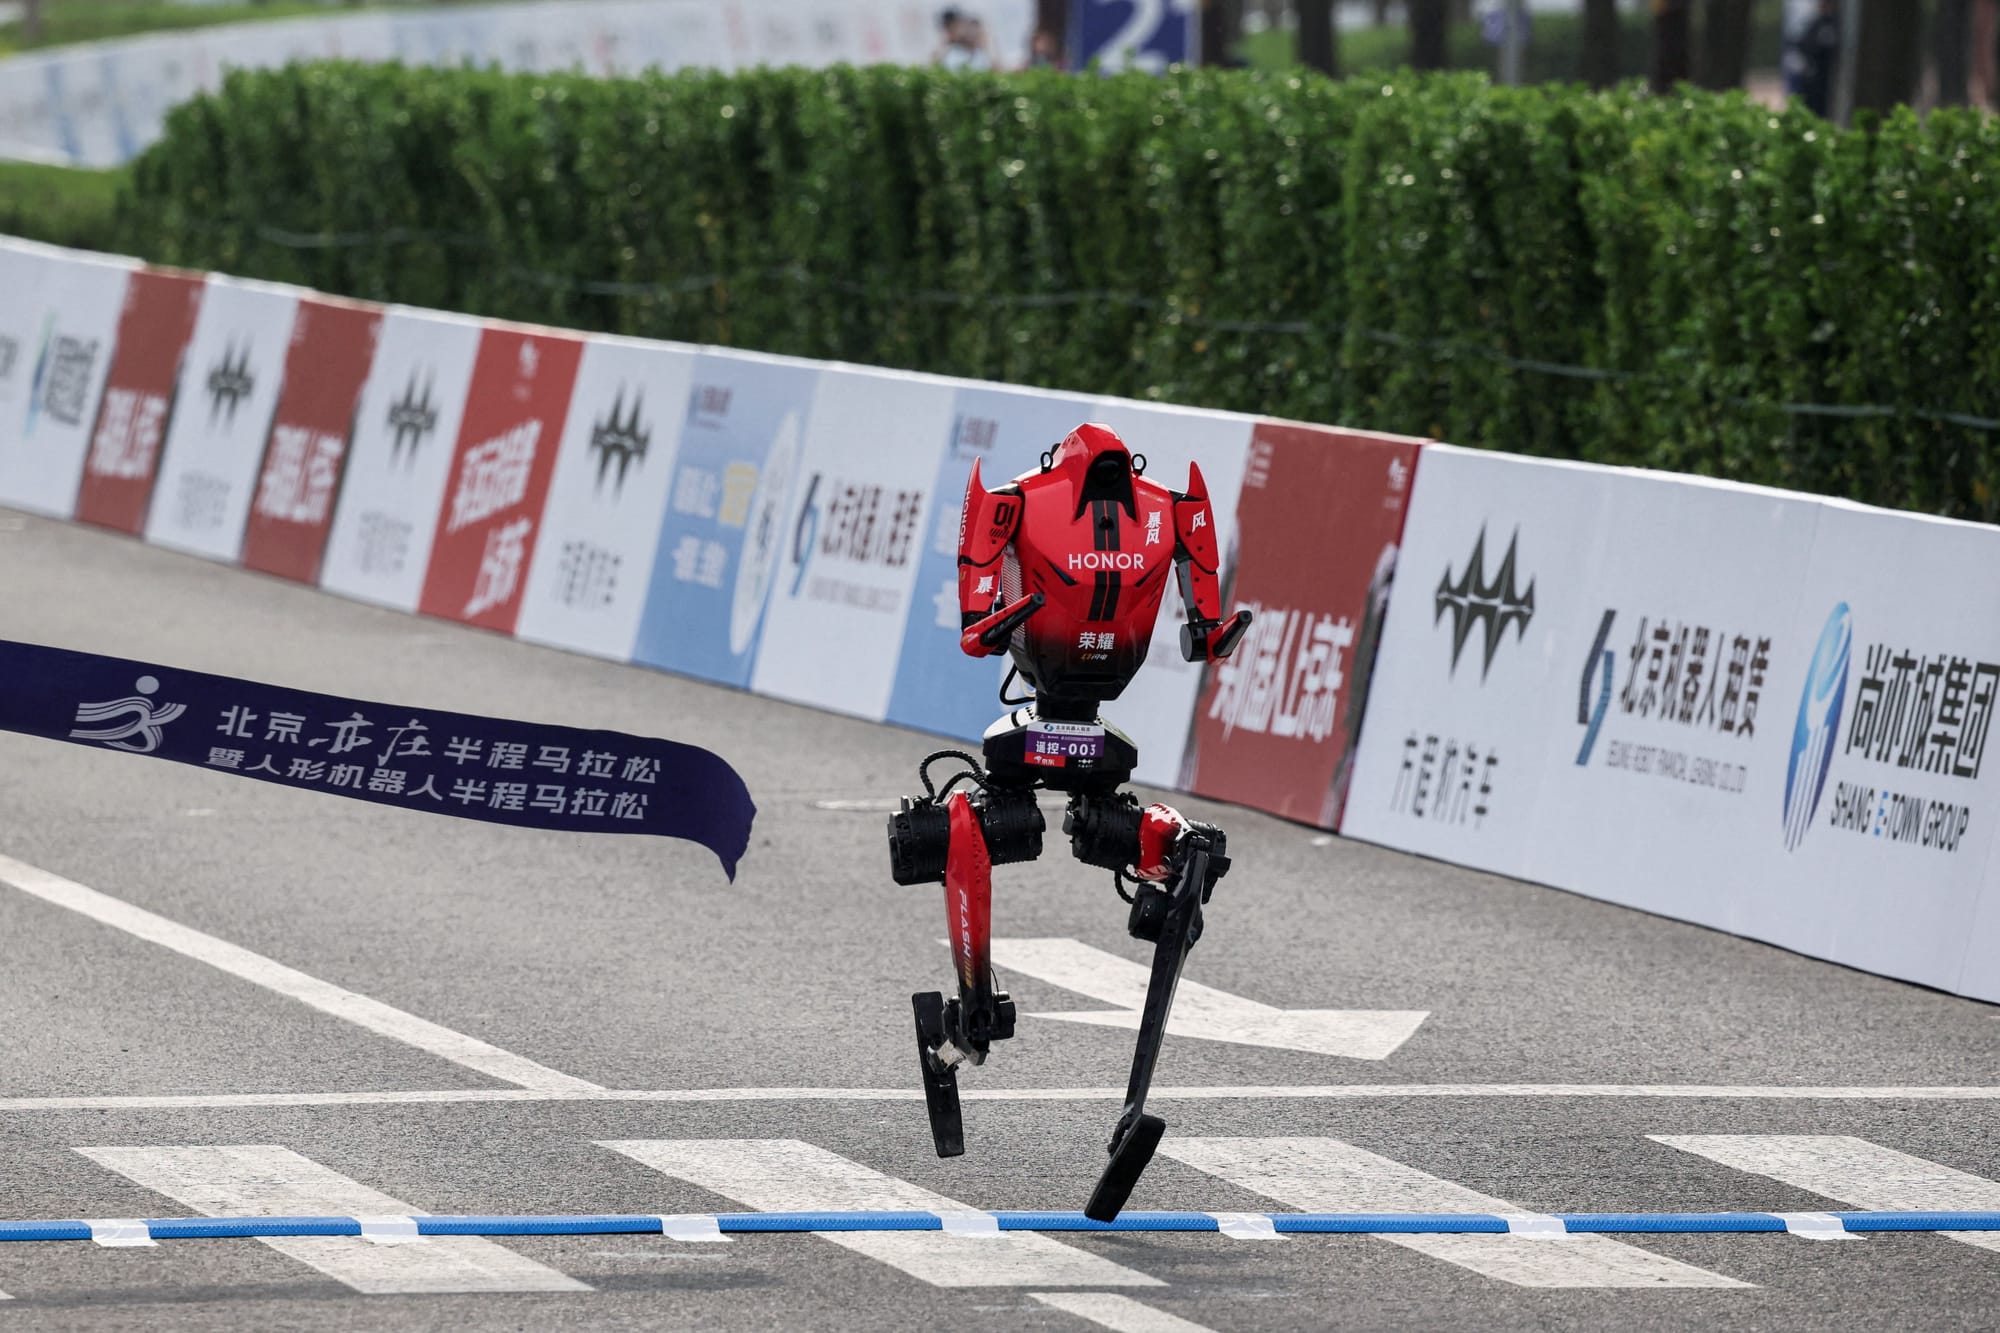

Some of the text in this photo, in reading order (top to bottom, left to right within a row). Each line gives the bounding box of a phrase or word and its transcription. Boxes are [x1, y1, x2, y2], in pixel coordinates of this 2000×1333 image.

[1145, 511, 1163, 546] 暴风
[1192, 509, 1207, 533] 风
[1068, 552, 1145, 570] HONOR
[1078, 632, 1115, 650] 荣耀
[1620, 616, 1771, 738] 北京机器人租赁
[1845, 643, 2000, 779] 尚亦城集团
[216, 704, 661, 784] 北京亦庄半程马拉松
[1036, 740, 1096, 756] 遥控-003
[204, 747, 649, 820] 暨人形机器人半程马拉松
[1831, 781, 1875, 834] SHANG
[1922, 800, 1970, 852] GROUP
[959, 889, 971, 958] FLASH
